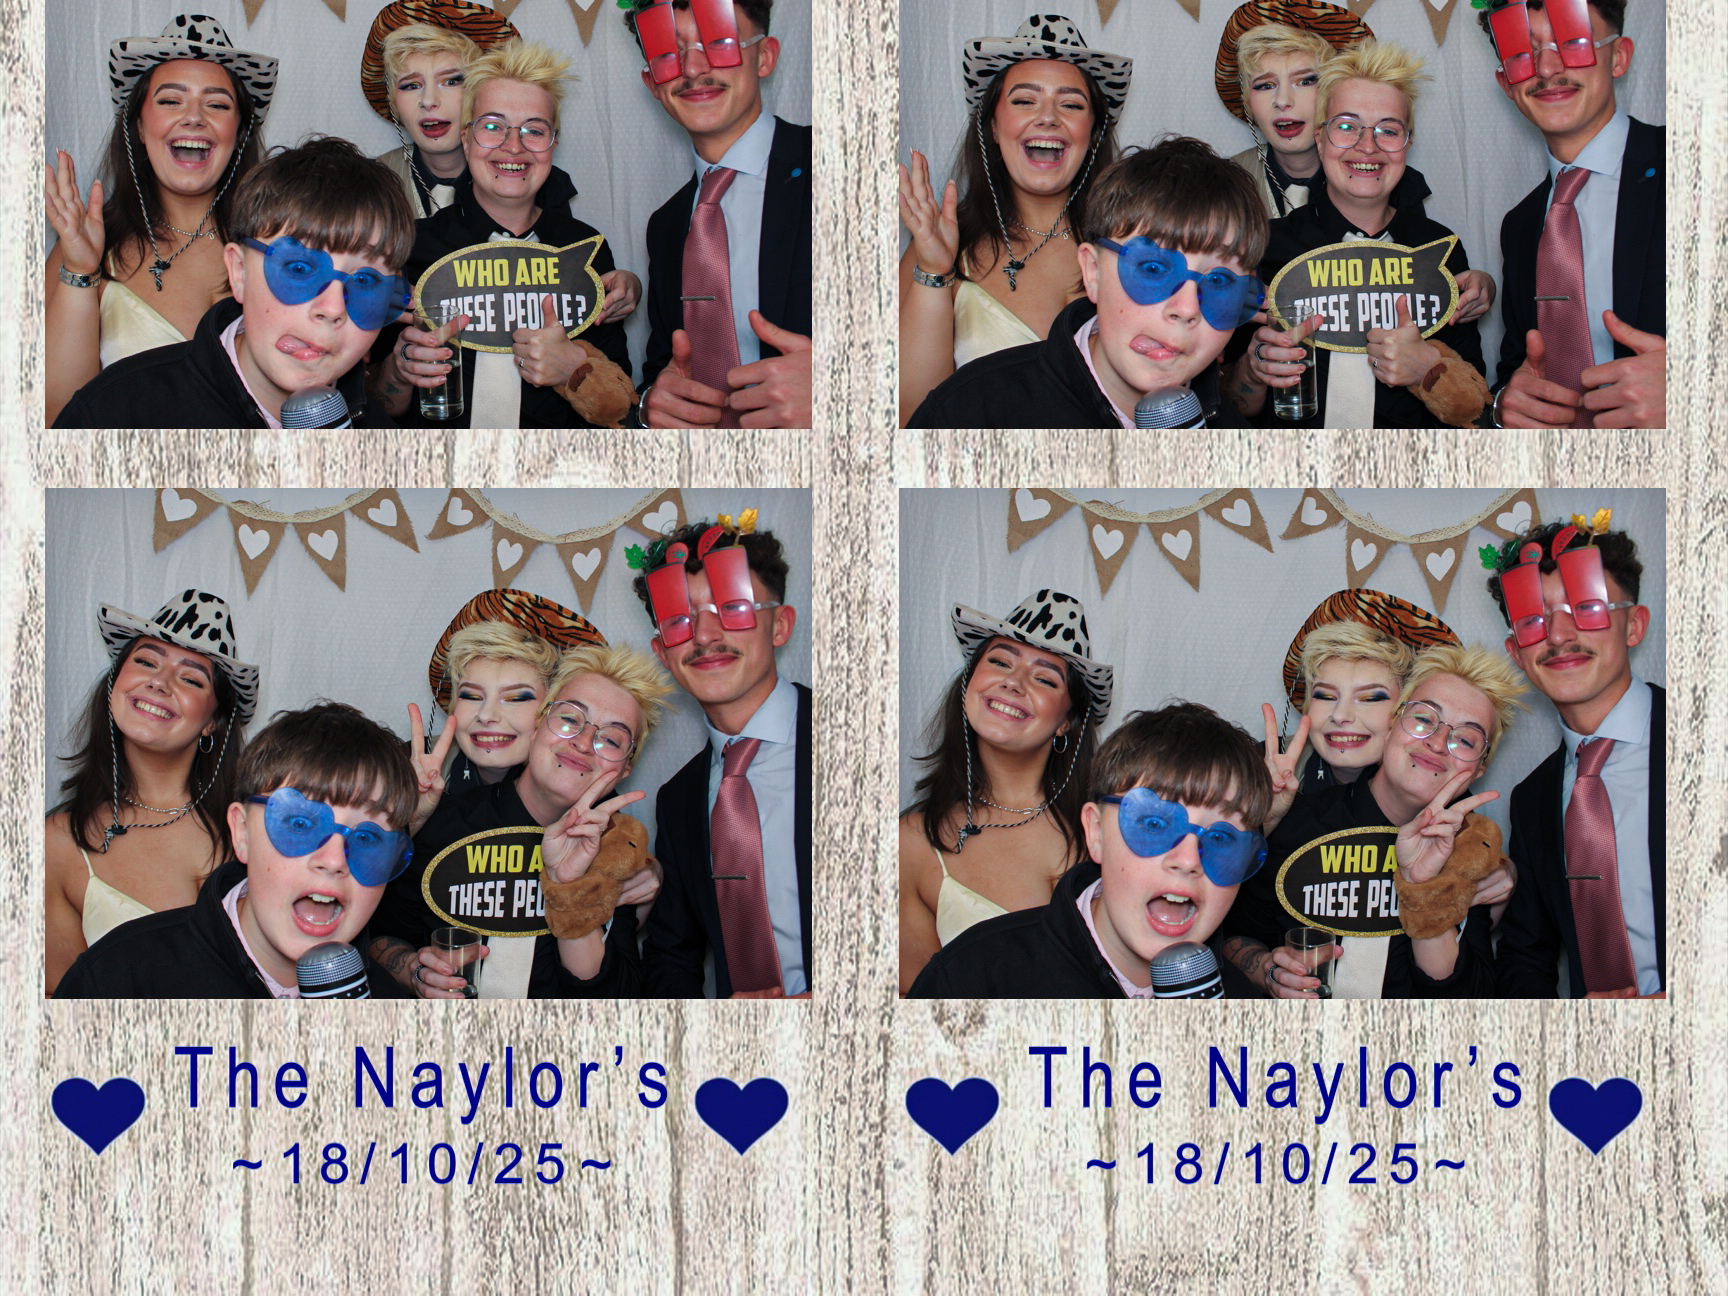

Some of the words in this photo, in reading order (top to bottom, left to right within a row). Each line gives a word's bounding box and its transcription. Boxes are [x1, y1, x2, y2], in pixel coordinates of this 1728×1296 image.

[452, 258, 510, 288] WHO
[514, 256, 561, 286] ARE
[1306, 258, 1364, 288] WHO
[1368, 256, 1415, 286] ARE
[466, 844, 525, 874] WHO
[1320, 844, 1379, 874] WHO
[448, 880, 507, 918] THESE
[1302, 880, 1361, 918] THESE
